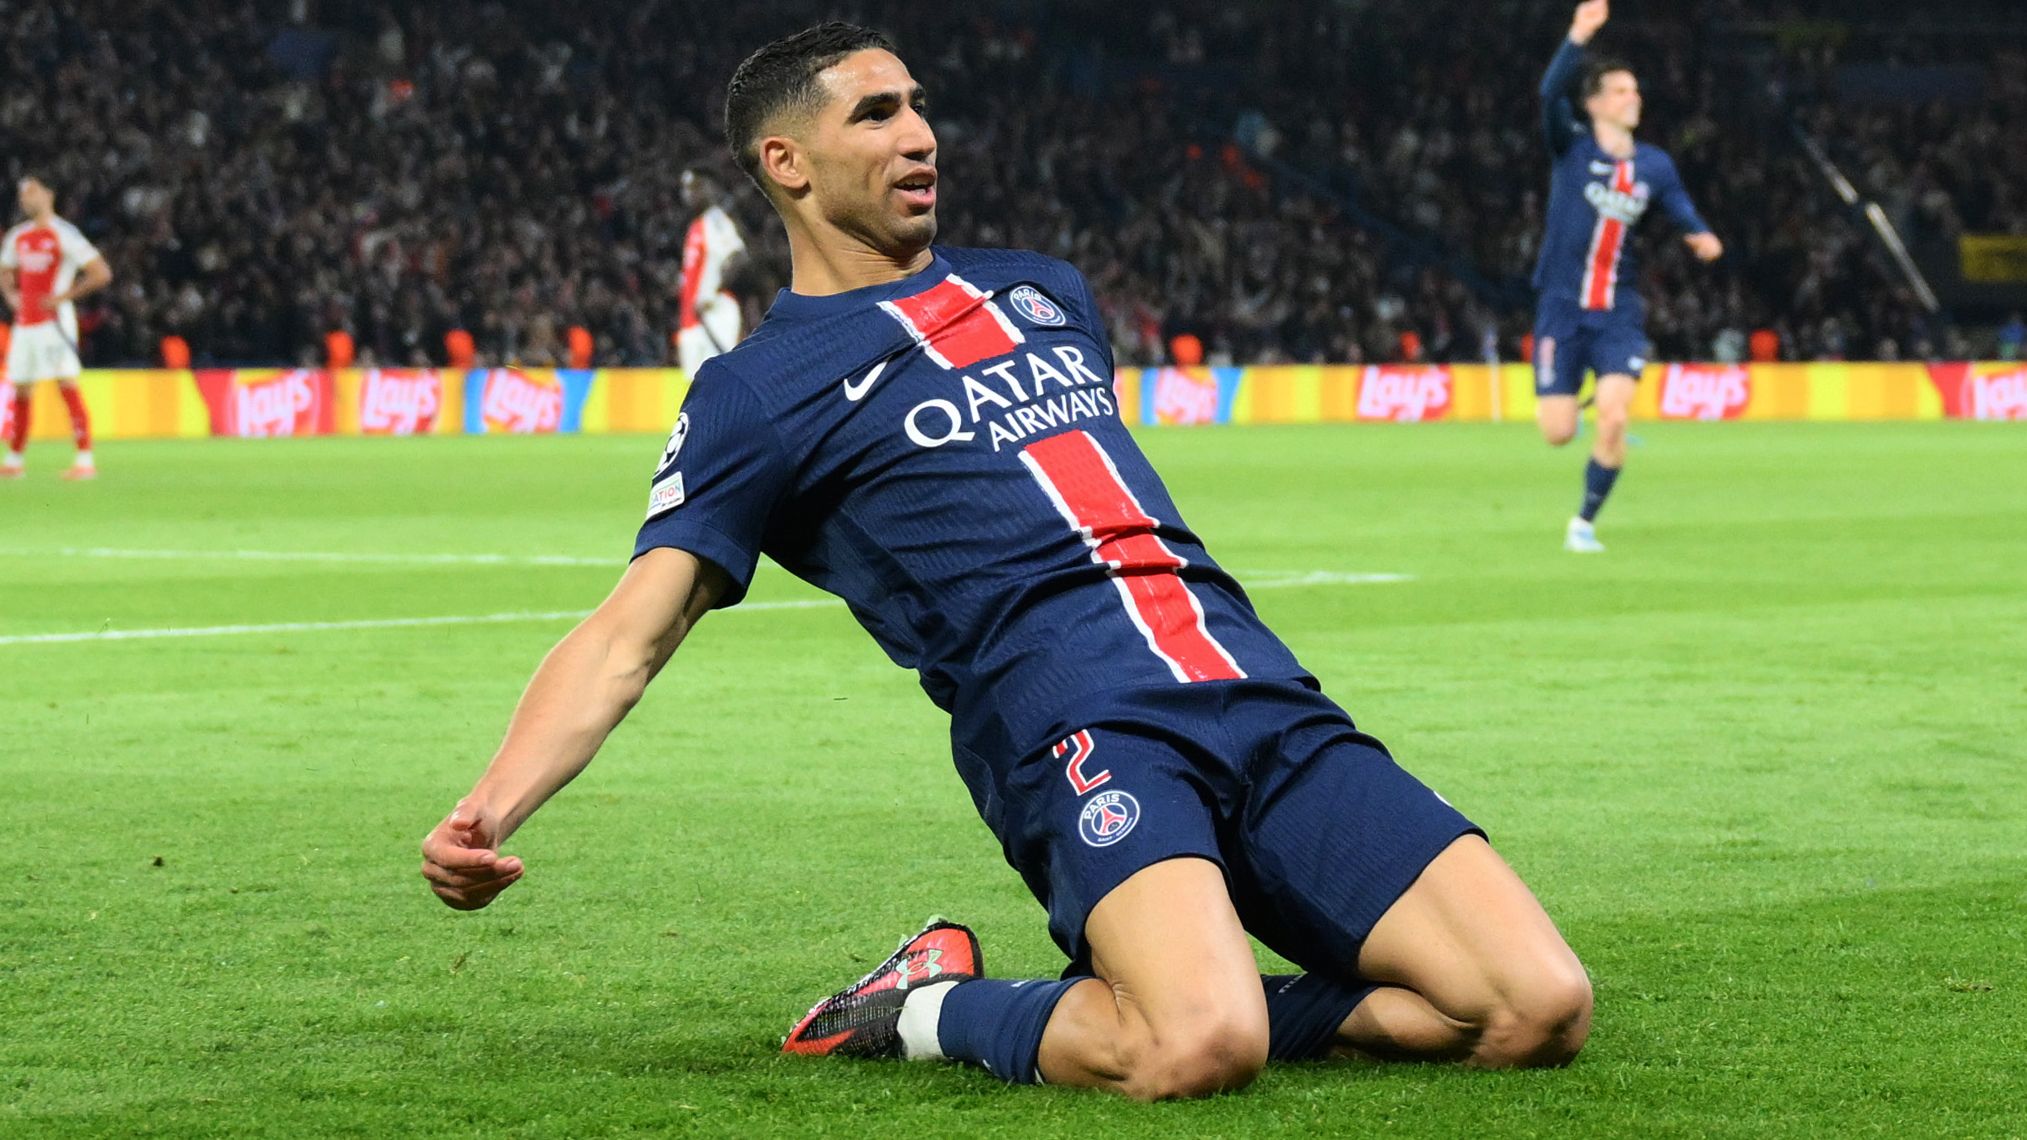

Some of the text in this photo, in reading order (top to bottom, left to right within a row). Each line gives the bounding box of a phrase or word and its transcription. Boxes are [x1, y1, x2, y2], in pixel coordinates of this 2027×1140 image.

[904, 345, 1103, 448] QATAR
[988, 387, 1113, 452] AIRWAYS
[1052, 729, 1112, 796] 2
[1083, 793, 1120, 820] PARIS
